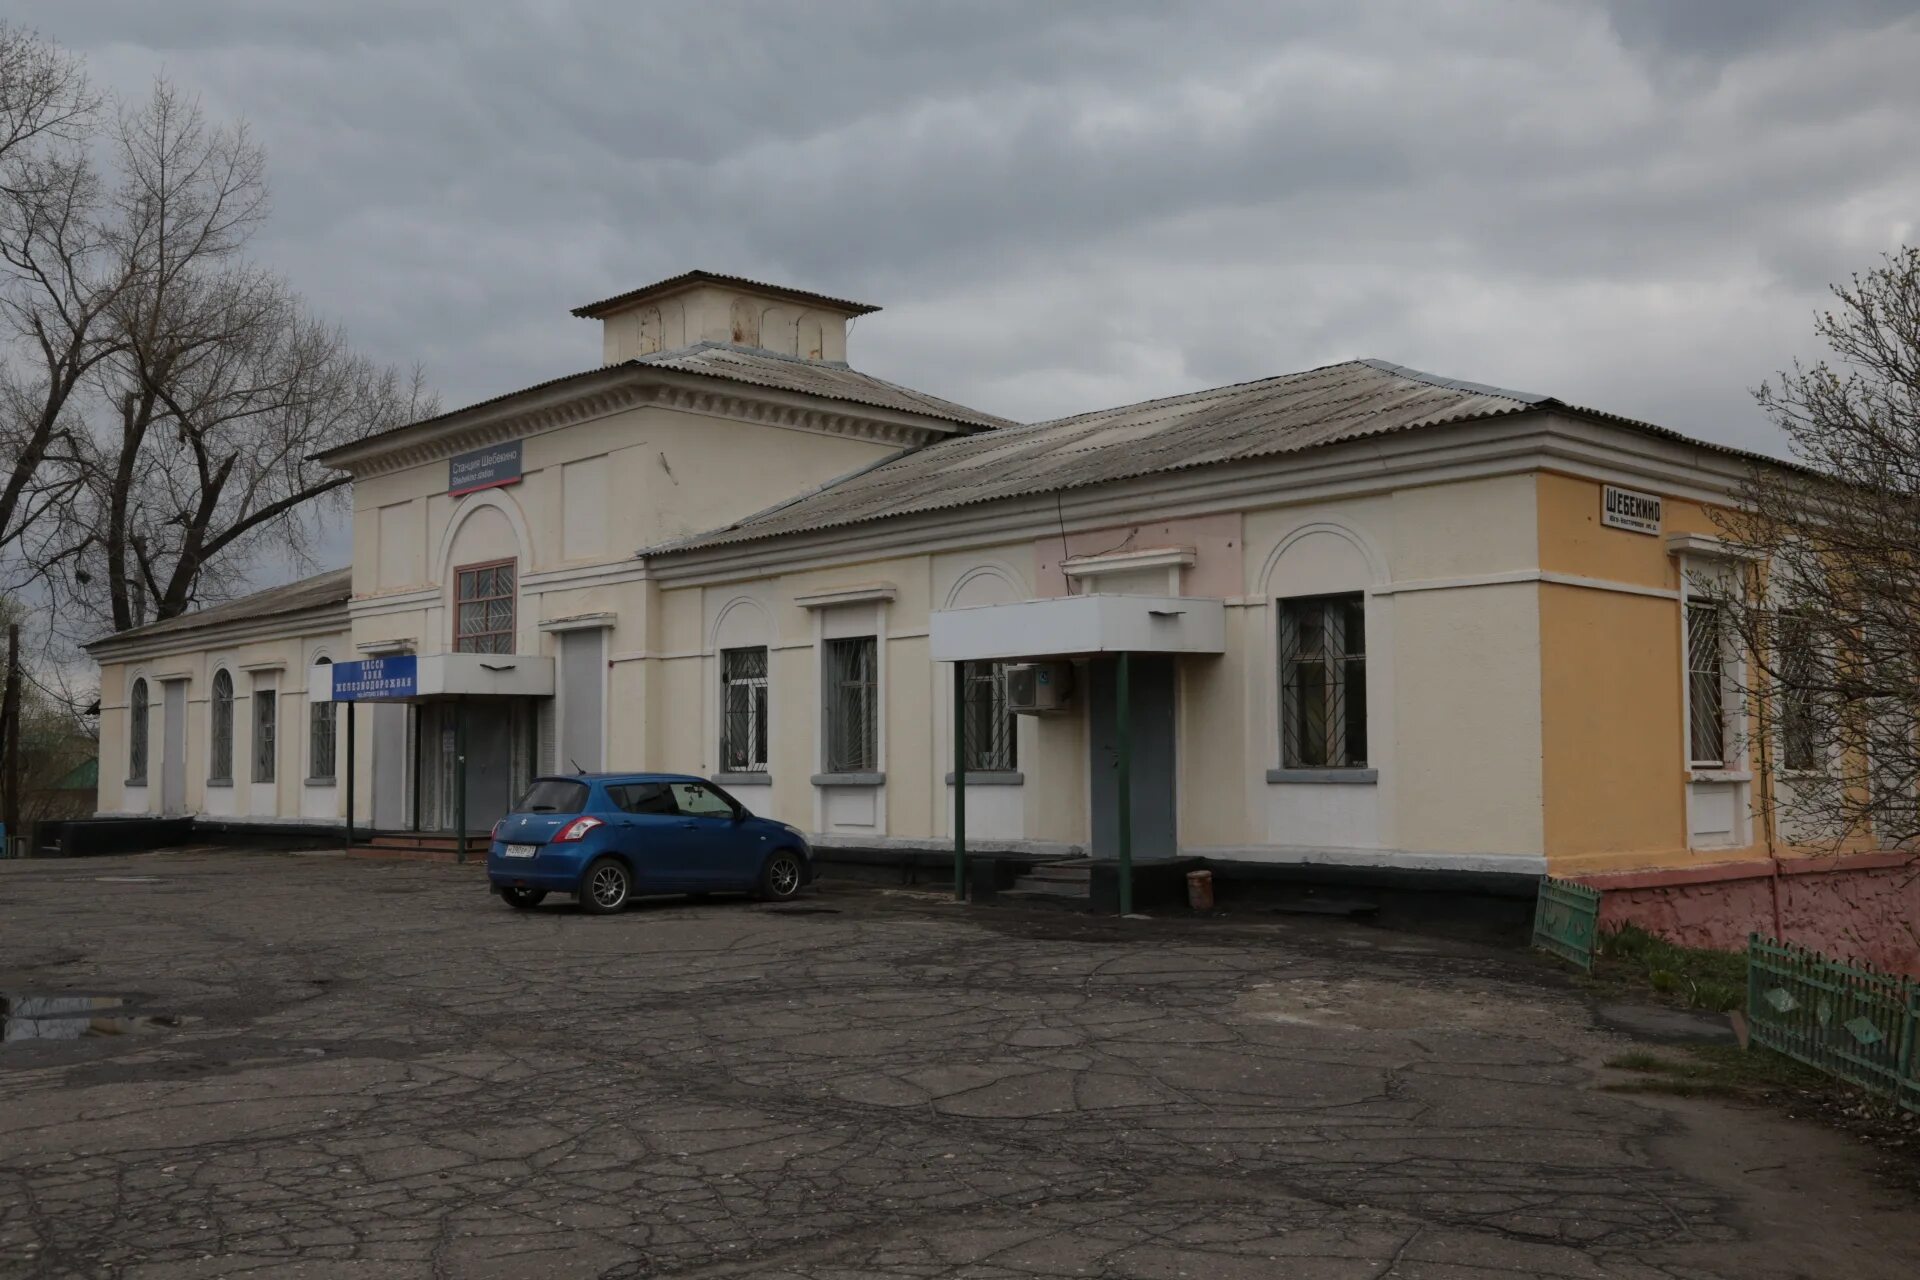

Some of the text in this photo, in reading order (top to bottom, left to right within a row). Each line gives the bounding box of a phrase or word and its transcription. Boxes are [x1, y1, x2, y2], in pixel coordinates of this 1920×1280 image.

[452, 450, 517, 474] Станция Шебекино
[1606, 487, 1660, 522] ШЕБЕКИНО
[361, 659, 384, 671] КАССА
[363, 669, 382, 680] АВИА
[335, 677, 412, 693] ЖЕЛЕЗНОДОРОЖНАЯ
